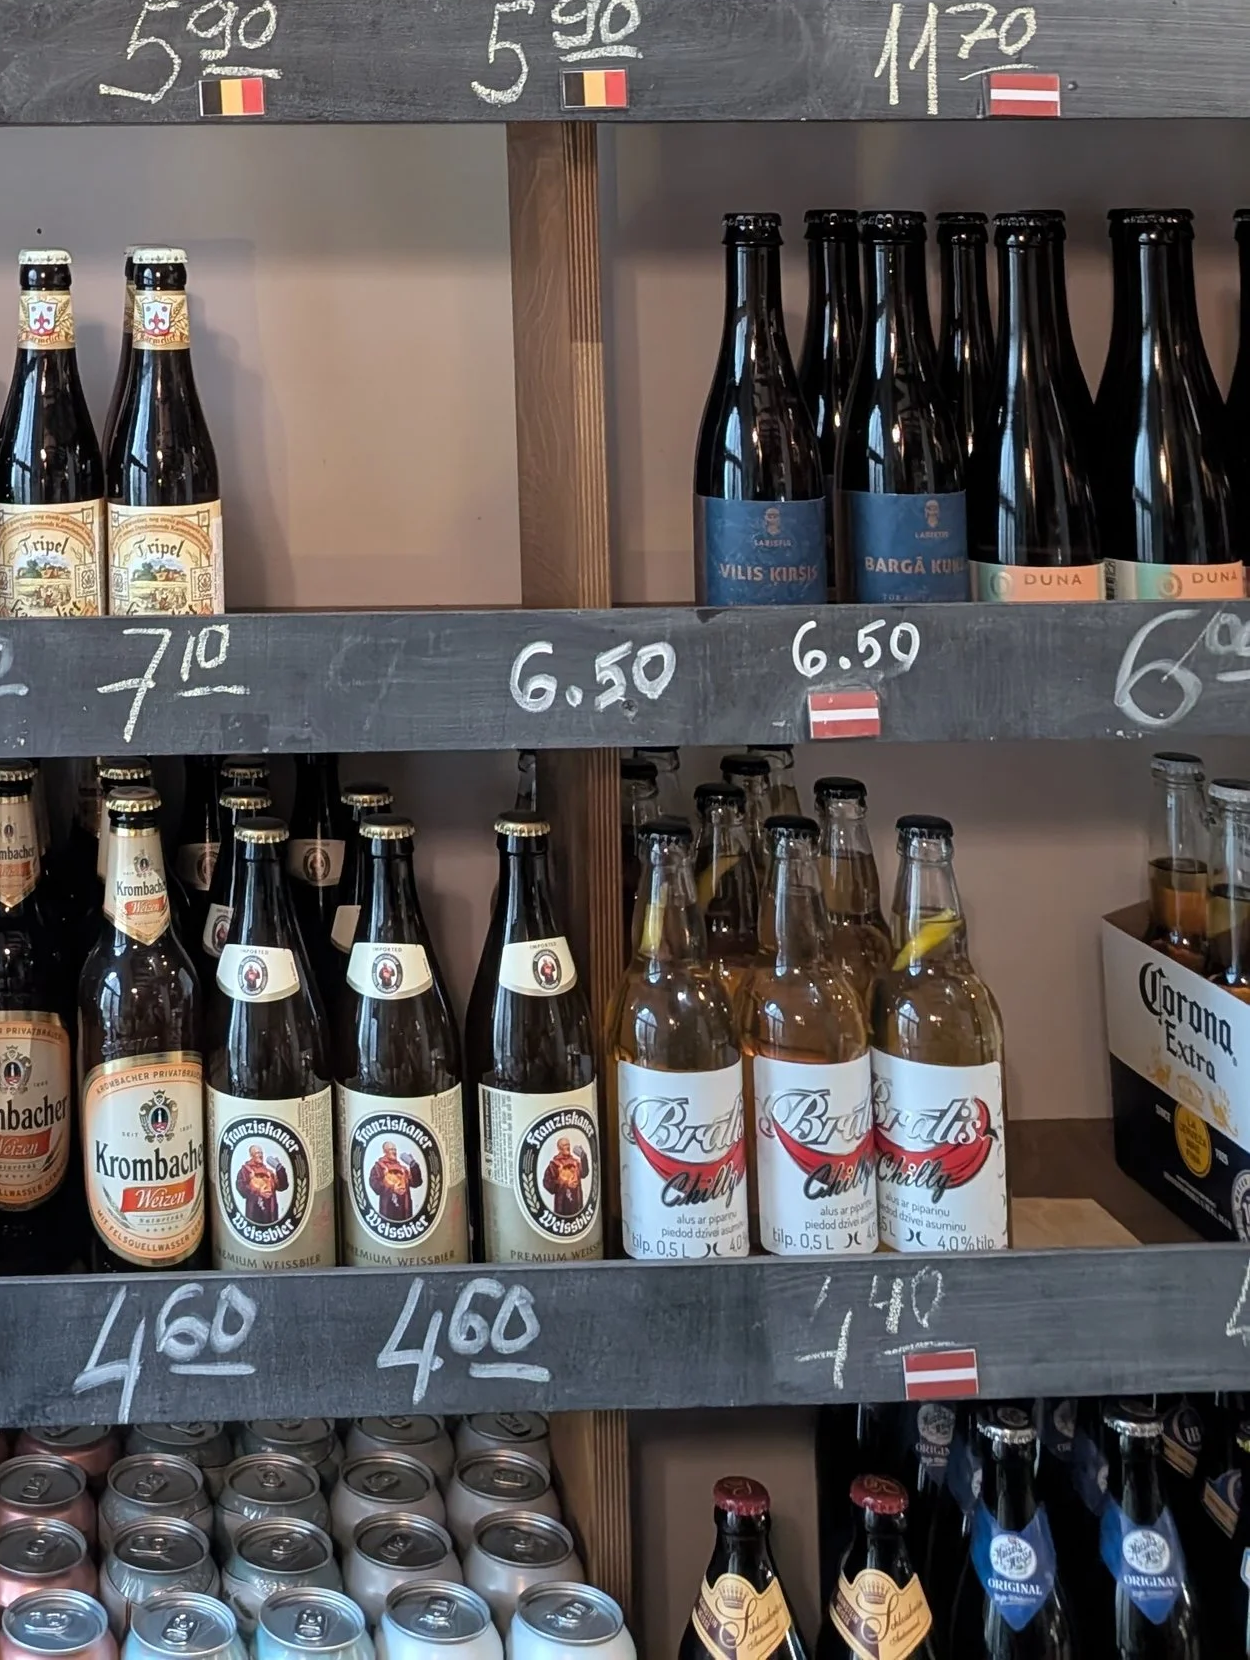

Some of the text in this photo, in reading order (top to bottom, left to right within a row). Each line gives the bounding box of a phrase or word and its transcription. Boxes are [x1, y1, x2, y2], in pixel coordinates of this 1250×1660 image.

[17, 532, 71, 560] Tripel
[132, 535, 186, 560] Tripel
[720, 562, 764, 581] VILIS
[1024, 573, 1083, 586] DUNA
[1192, 571, 1238, 585] DUNA
[791, 619, 921, 679] 6.50
[508, 640, 678, 715] 6.50
[1138, 961, 1235, 1057] Corona
[1164, 1020, 1217, 1083] Extra
[222, 1118, 300, 1155] Franziskaner
[355, 1115, 433, 1150] Franziskaner
[526, 1110, 595, 1150] Franziskaner
[95, 1139, 204, 1182] Krombache
[661, 1160, 740, 1209] Chilly
[876, 1152, 951, 1205] Chilly
[135, 1189, 186, 1209] Weizen
[231, 1212, 296, 1244] Weissbier
[364, 1211, 430, 1240] Weissbier
[539, 1203, 595, 1238] Weissbier
[677, 1214, 696, 1224] alus
[661, 1227, 694, 1240] piedod
[261, 1253, 322, 1271] WEISSBIER
[395, 1249, 456, 1268] WEISSBIER
[509, 1248, 568, 1264] PREMIUM
[987, 1579, 1043, 1596] ORIGINAL
[1123, 1575, 1178, 1588] ORIGINAL
